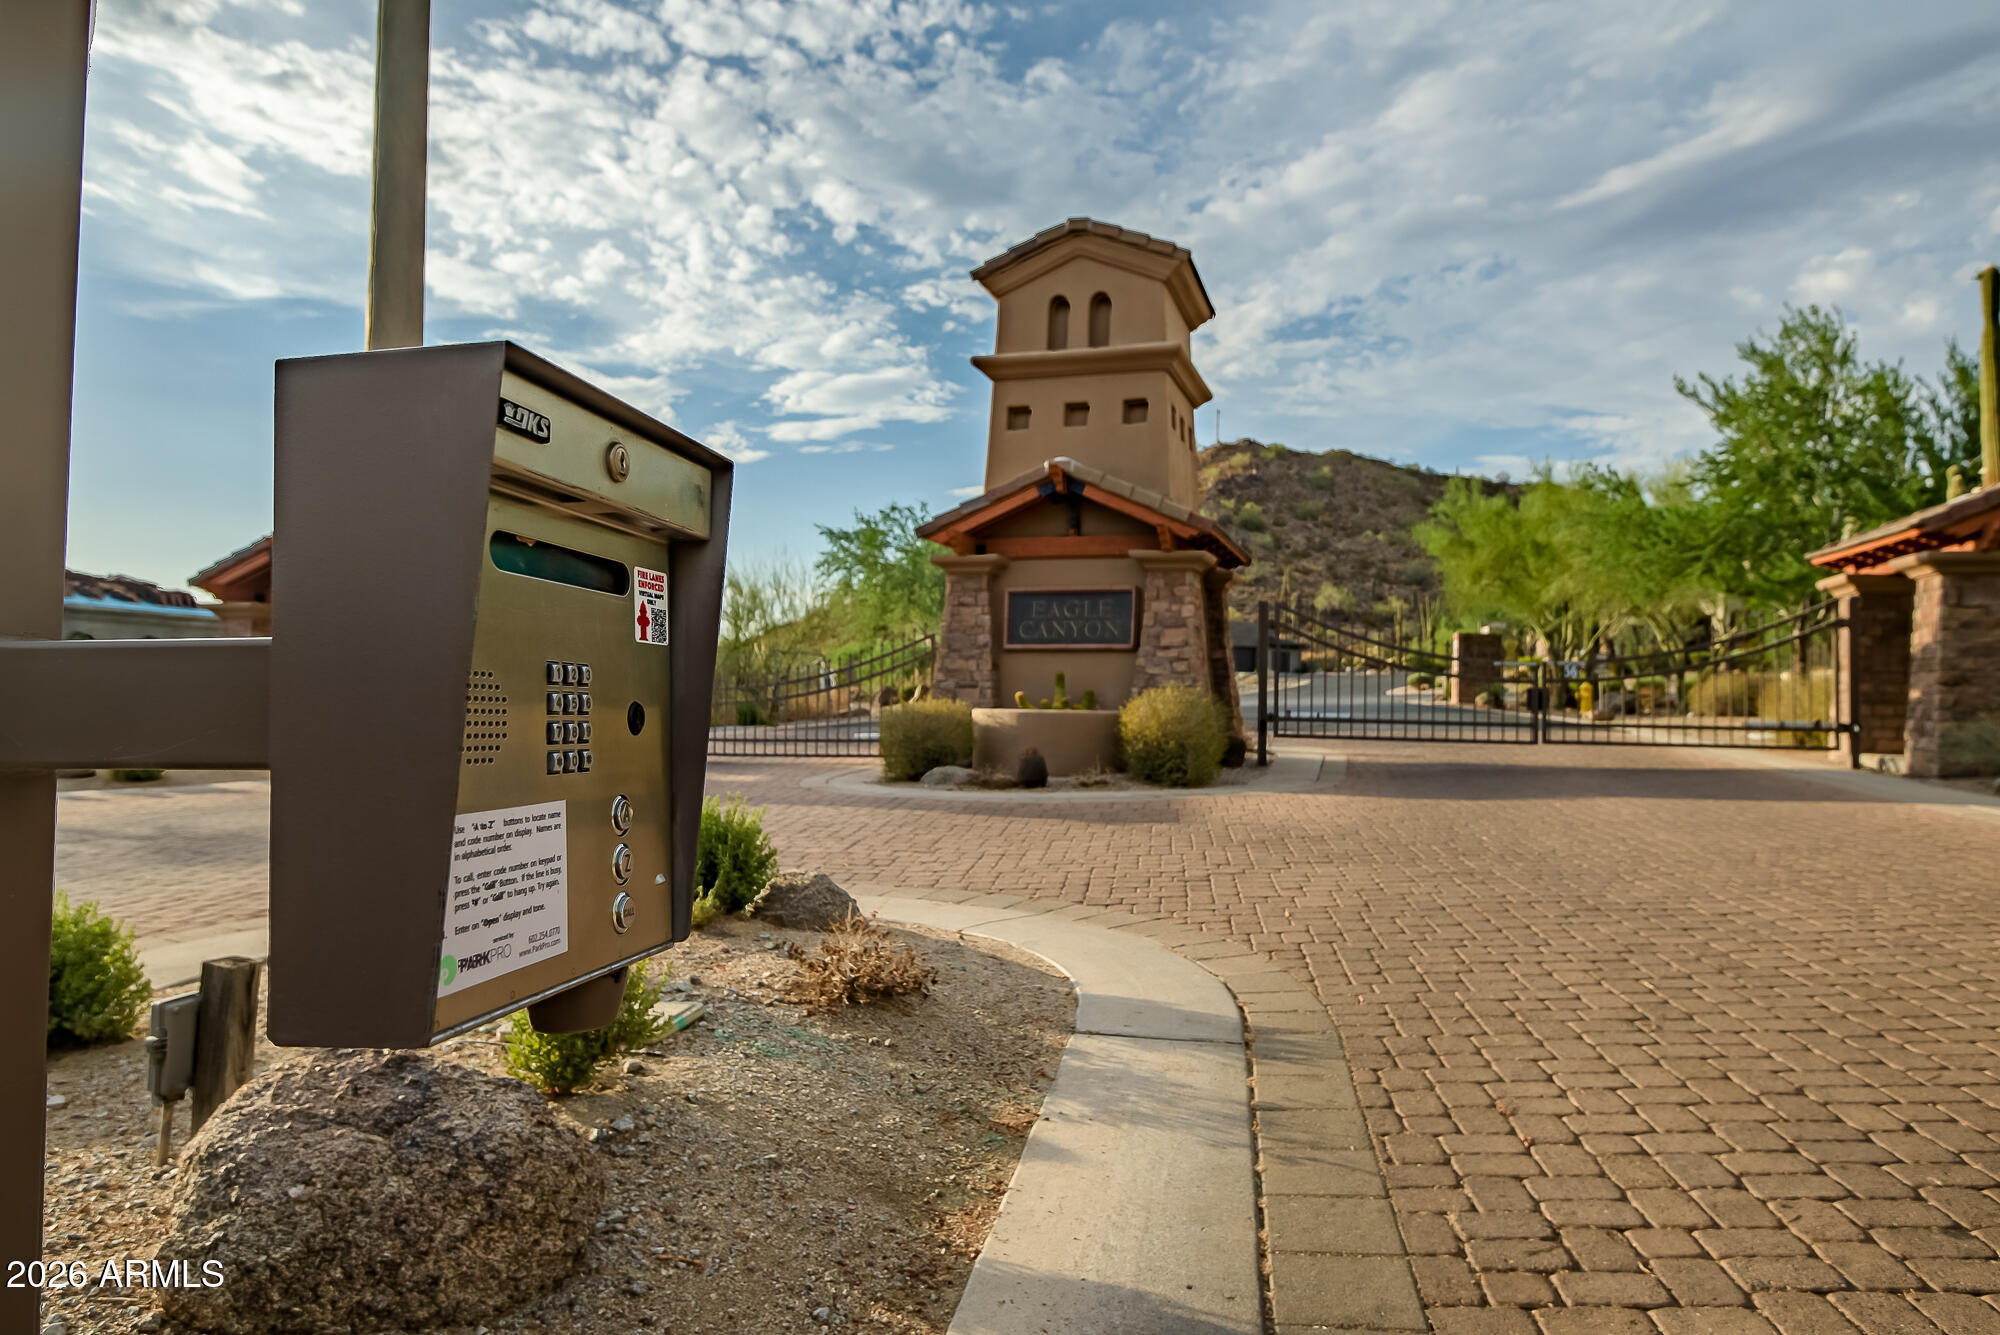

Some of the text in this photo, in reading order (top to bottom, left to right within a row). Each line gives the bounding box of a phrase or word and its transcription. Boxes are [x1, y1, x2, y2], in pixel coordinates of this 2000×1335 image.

[637, 570, 664, 583] FIRE LANES
[638, 580, 664, 592] ENFORCED
[1031, 599, 1113, 618] EAGLE
[1019, 620, 1118, 639] CANYON
[531, 814, 546, 822] locate
[547, 811, 561, 819] name
[454, 838, 466, 848] and
[467, 836, 481, 846] code
[483, 832, 505, 843] number
[506, 831, 513, 839] on
[536, 824, 553, 833] Names
[454, 853, 460, 861] in
[461, 846, 496, 861] alphabetical
[454, 875, 461, 884] To
[476, 870, 492, 880] enter
[493, 866, 507, 876] code
[508, 861, 529, 872] number
[538, 854, 555, 866] keypad
[454, 888, 470, 900] press
[471, 885, 480, 893] the
[525, 872, 535, 880] the
[535, 869, 544, 878] line
[454, 902, 470, 914] press
[514, 887, 527, 897] hang
[537, 882, 545, 891] Try
[454, 926, 470, 935] Enter
[471, 922, 479, 931] on
[502, 910, 521, 922] display
[522, 906, 532, 915] and
[623, 907, 634, 918] CALL
